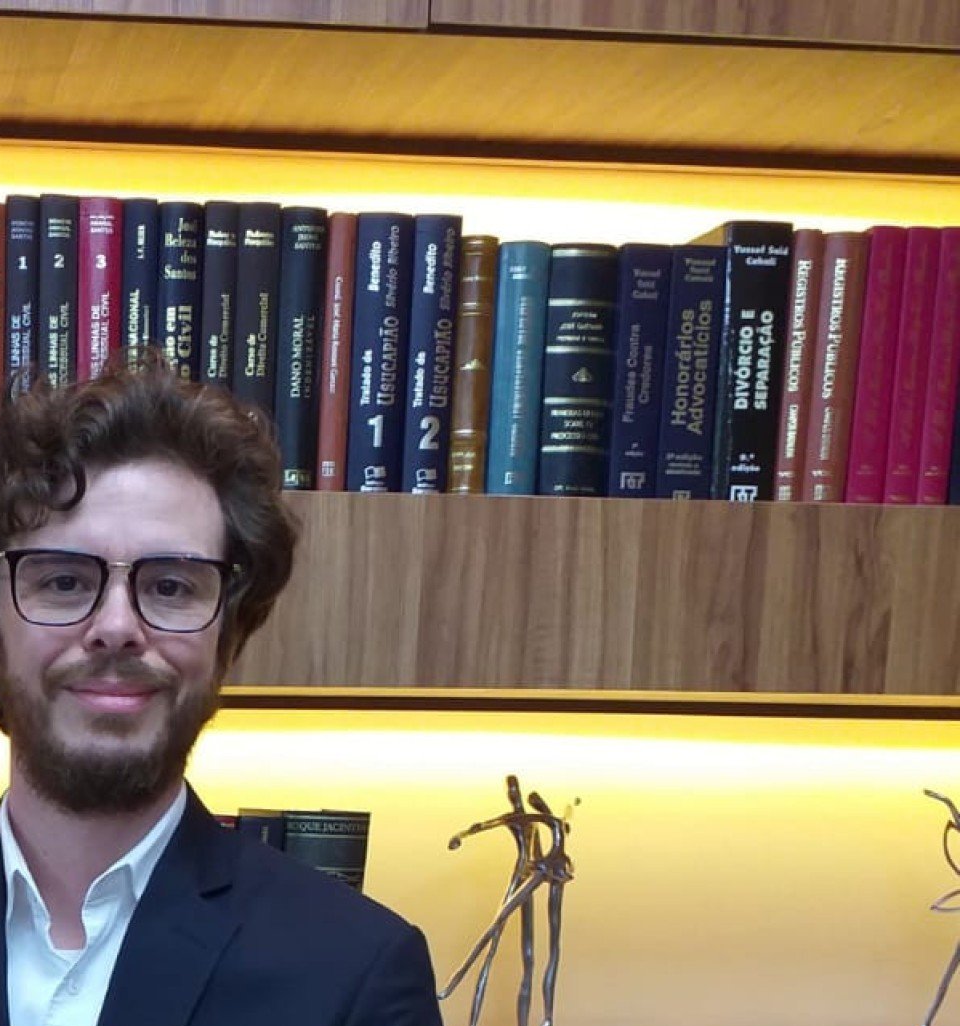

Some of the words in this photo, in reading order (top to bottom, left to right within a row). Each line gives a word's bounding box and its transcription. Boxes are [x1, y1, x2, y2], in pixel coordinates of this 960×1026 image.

[18, 255, 28, 270] 1
[53, 254, 65, 269] 2
[95, 254, 107, 269] 3
[367, 241, 382, 292] Benedito
[422, 243, 438, 294] Benedito
[100, 290, 110, 317] CIVIL
[793, 260, 812, 329] REGISTROS
[829, 258, 848, 331] REGISTROS
[10, 314, 20, 329] DE
[21, 300, 31, 326] CIVIL
[49, 314, 58, 329] DE
[59, 301, 70, 327] CIVIL
[90, 305, 100, 320] DE
[740, 308, 756, 320] E
[90, 321, 100, 359] LINHAS
[177, 305, 193, 359] Civil
[208, 334, 219, 347] de
[245, 333, 256, 346] de
[290, 315, 303, 361] MORAL
[626, 325, 641, 368] Contra
[10, 333, 20, 367] LINHAS
[49, 332, 58, 367] LINHAS
[207, 347, 219, 378] Curso
[244, 347, 255, 376] Curso
[753, 309, 776, 411] SEPARAÇÃO
[290, 361, 302, 399] DANO
[670, 308, 695, 426] Honorários
[686, 300, 713, 436] Advocatícios
[733, 326, 754, 411] DIVÓRCIO
[360, 366, 373, 406] Tratado
[412, 367, 426, 407] Tratado
[621, 371, 637, 423] Fraudes
[367, 414, 384, 448] 1
[419, 416, 440, 449] 2
